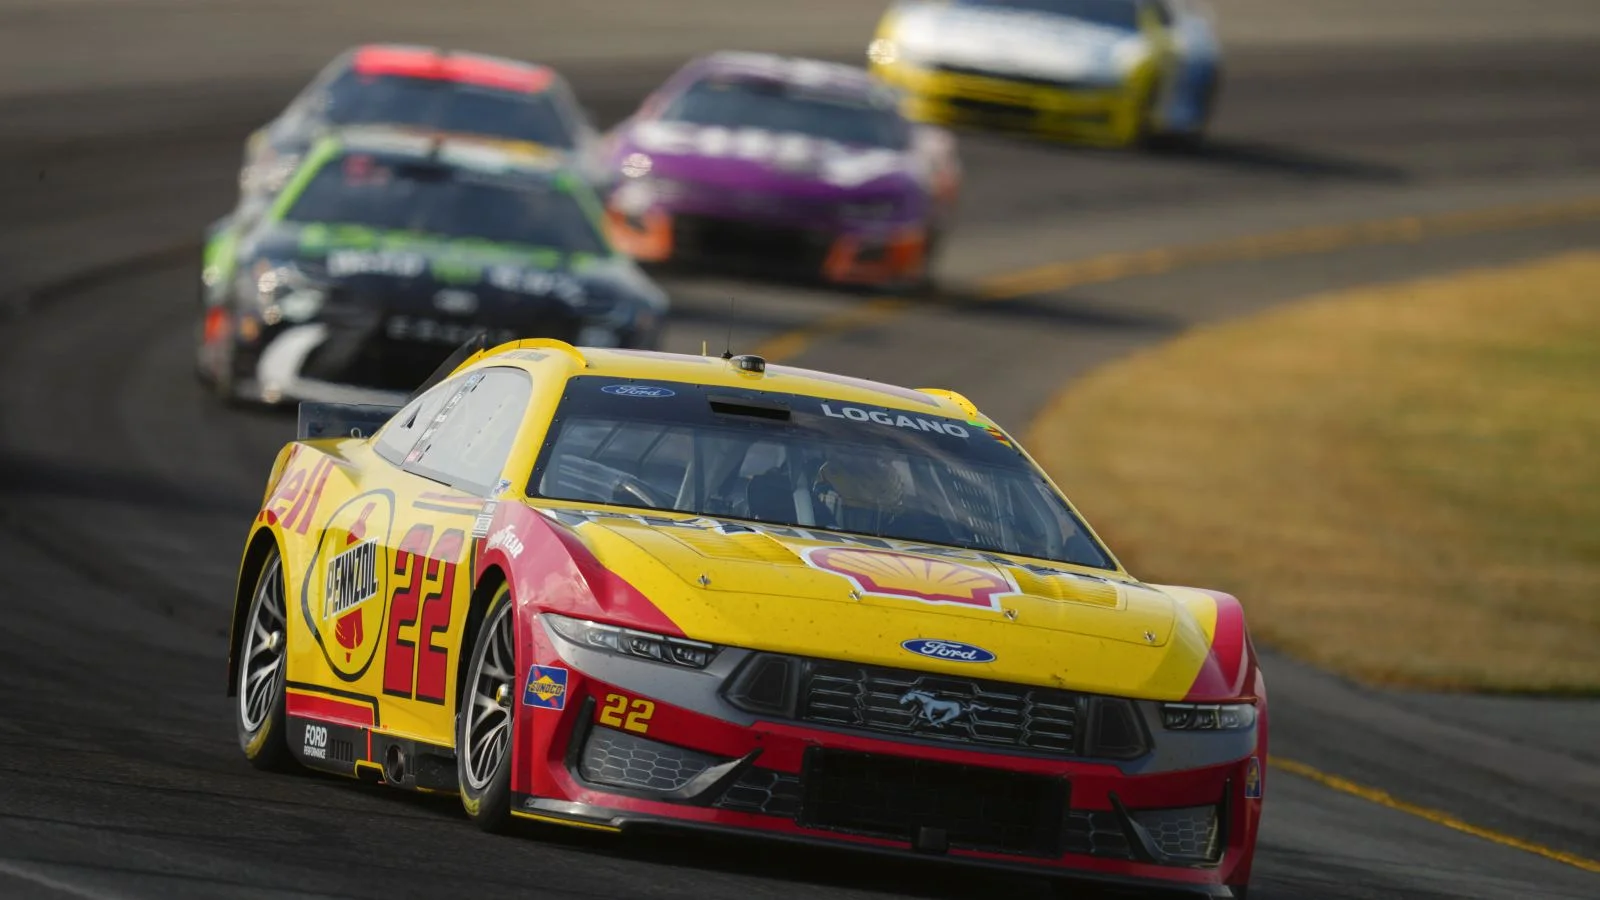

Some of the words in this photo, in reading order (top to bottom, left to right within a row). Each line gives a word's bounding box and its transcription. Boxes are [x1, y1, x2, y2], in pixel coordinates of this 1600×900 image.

[821, 403, 970, 438] LOGANO
[268, 455, 335, 535] ell
[323, 537, 380, 621] PENNZOIL
[383, 523, 465, 706] 22
[920, 640, 977, 660] Ford
[529, 681, 564, 695] SUNOCO
[599, 693, 655, 733] 22
[304, 724, 328, 747] FORD
